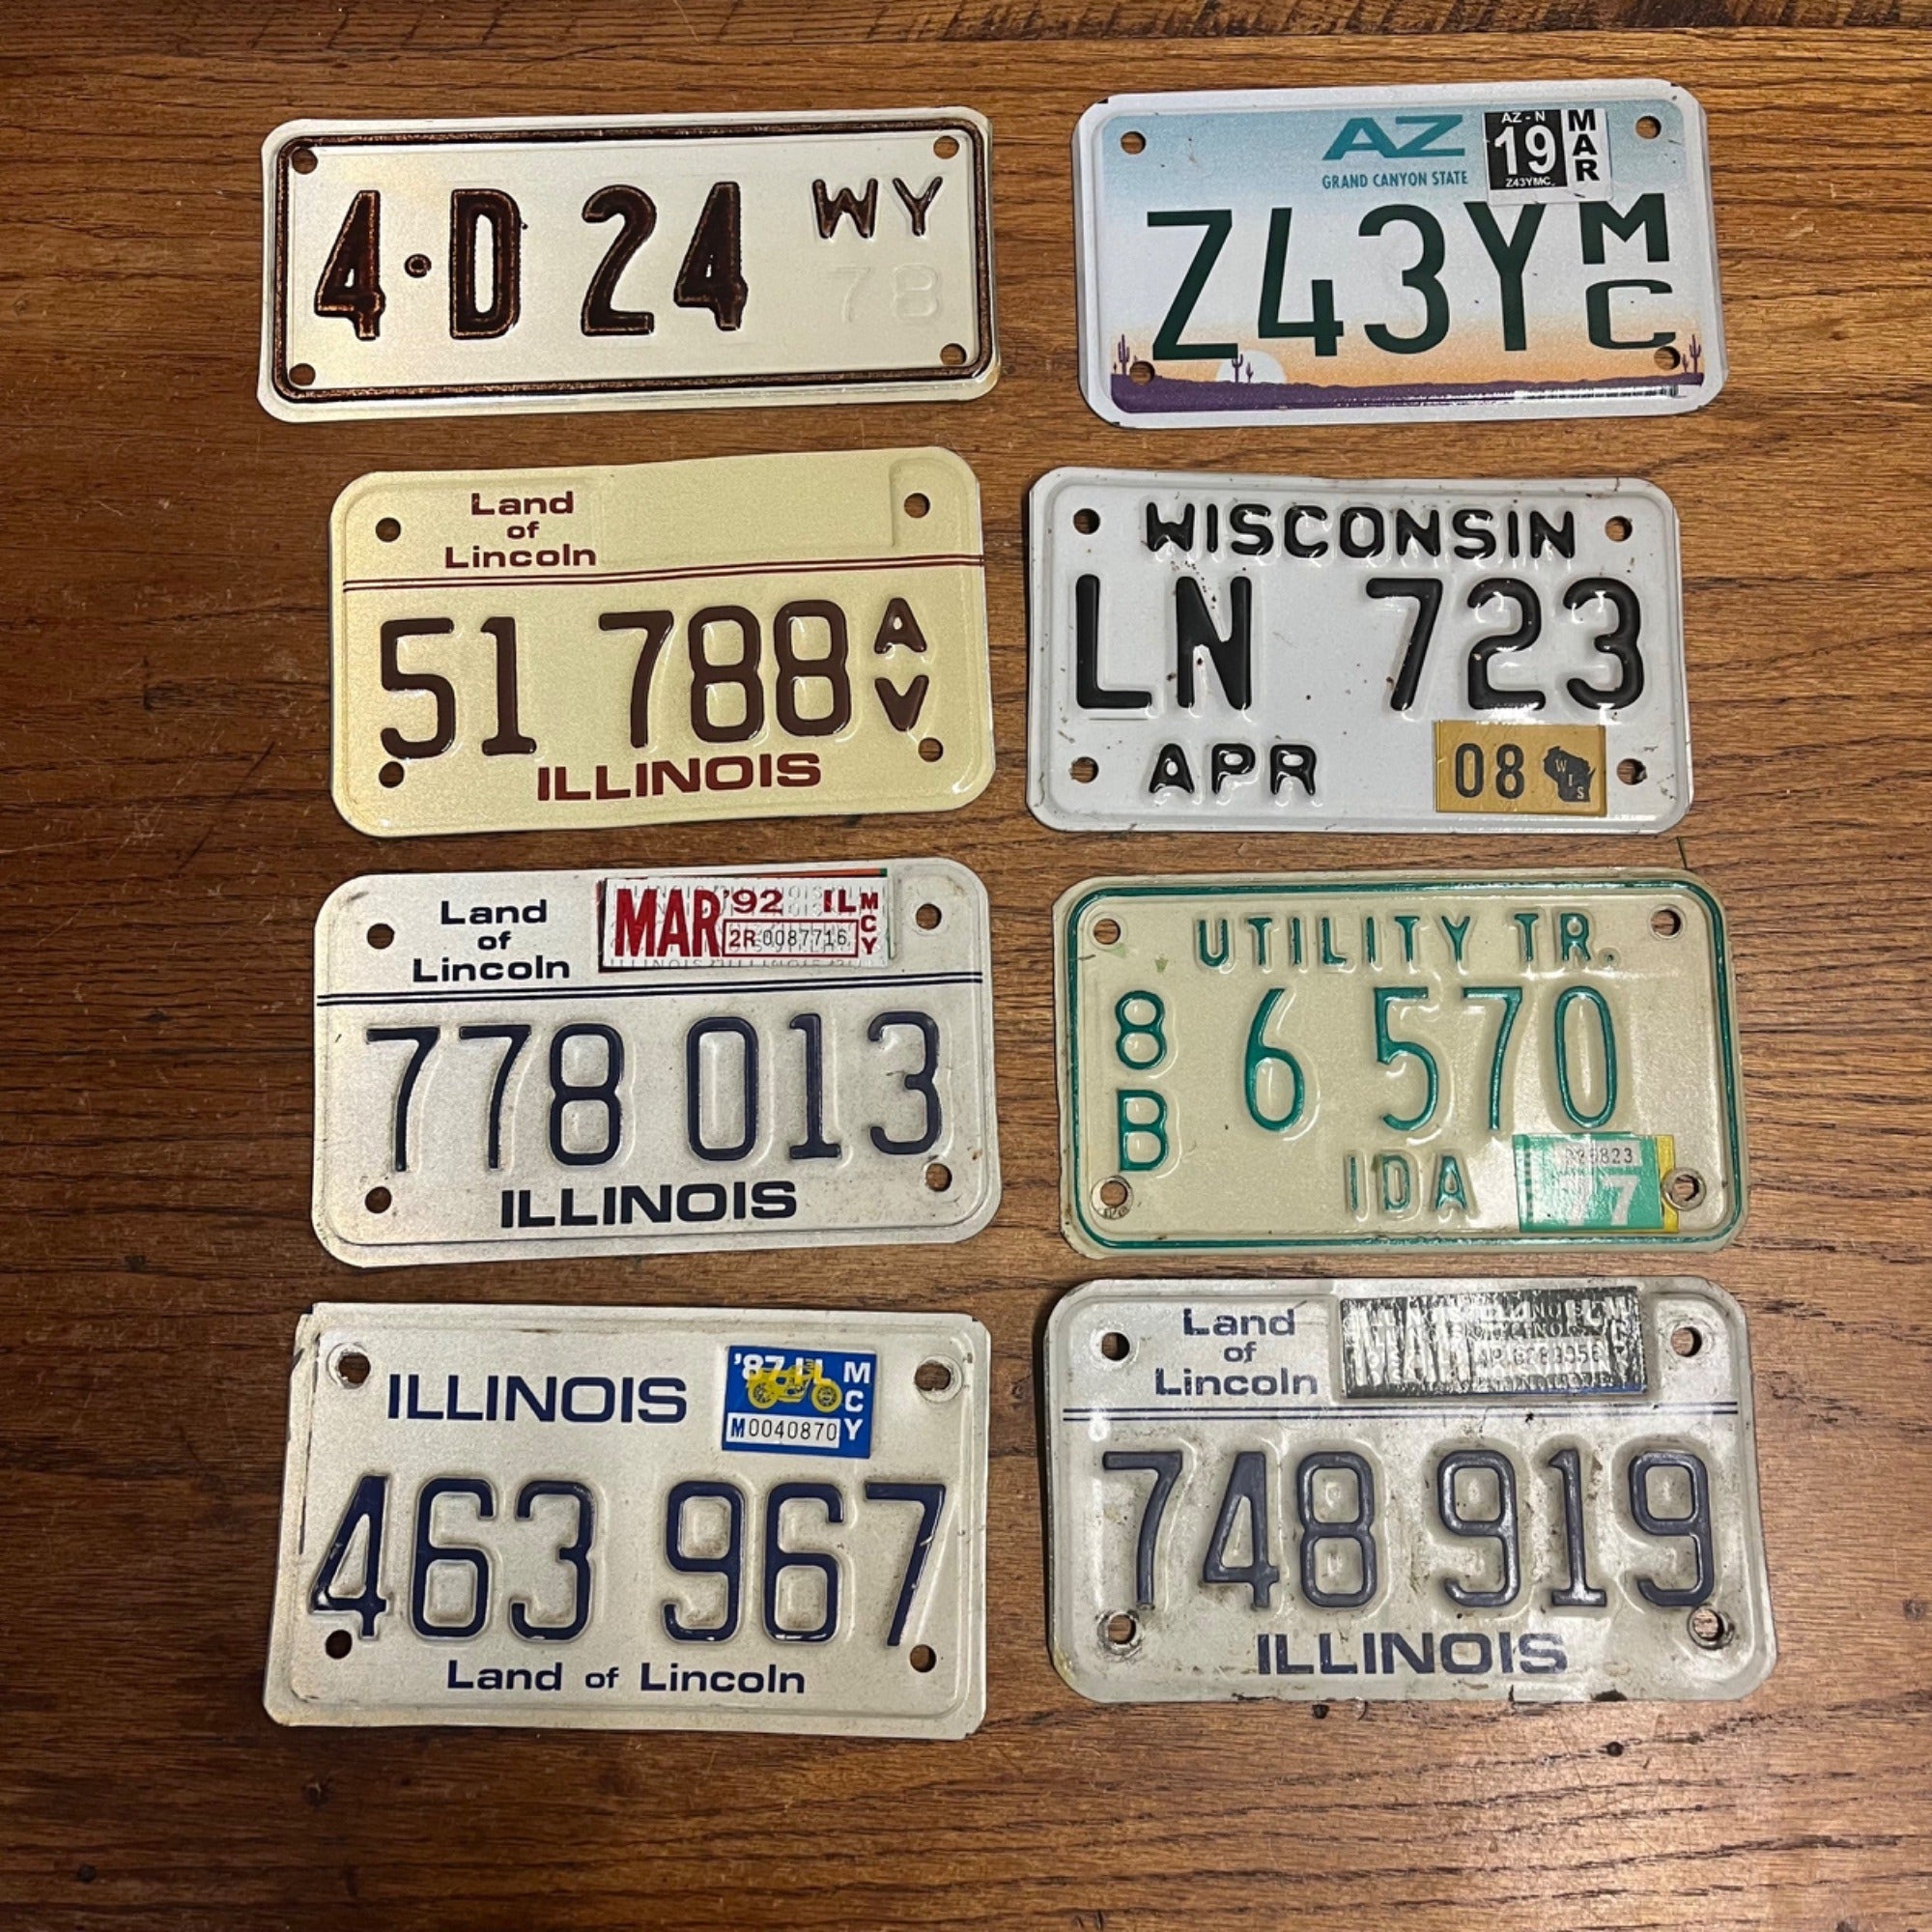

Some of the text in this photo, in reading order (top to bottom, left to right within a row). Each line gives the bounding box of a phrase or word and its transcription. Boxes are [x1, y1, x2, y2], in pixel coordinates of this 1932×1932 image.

[1321, 114, 1466, 160] AZ
[1501, 112, 1522, 124] AZ
[1494, 125, 1556, 176] 19
[1568, 109, 1600, 182] MAR
[1322, 170, 1468, 189] GRAND CANYON STATE
[812, 176, 943, 240] WY
[581, 183, 749, 336] 24
[1147, 200, 1546, 361] Z43Y
[827, 263, 939, 325] 78
[470, 491, 574, 517] Land
[506, 519, 539, 540] of
[1146, 501, 1576, 559] WISCONSIN
[445, 544, 597, 569] Lincoln
[1075, 575, 1643, 711] LN 723
[380, 599, 852, 760] 51 788
[537, 753, 822, 803] ILLINOIS
[1149, 743, 1317, 796] APR
[1455, 743, 1524, 799] 08
[440, 898, 548, 925] Land
[614, 888, 722, 957] MAR
[724, 890, 783, 914] '92
[823, 890, 856, 913] IL
[478, 929, 511, 952] of
[729, 928, 847, 947] 2R 0087716
[1198, 912, 1617, 968] UTILITY TR.
[412, 957, 570, 983] Lincoln
[1245, 984, 1617, 1132] 6 570
[366, 1010, 940, 1173] 778 013
[500, 1180, 797, 1229] ILLINOIS
[1349, 1154, 1471, 1211] IDA
[1183, 1307, 1295, 1337] Land
[1223, 1340, 1256, 1363] of
[387, 1373, 687, 1424] ILLINOIS
[1154, 1367, 1319, 1397] Lincoln
[1103, 1449, 1715, 1609] 748 919
[311, 1474, 947, 1647] 463 967
[447, 1662, 806, 1695] Land of Lincoln
[1257, 1632, 1567, 1676] ILLINOIS
